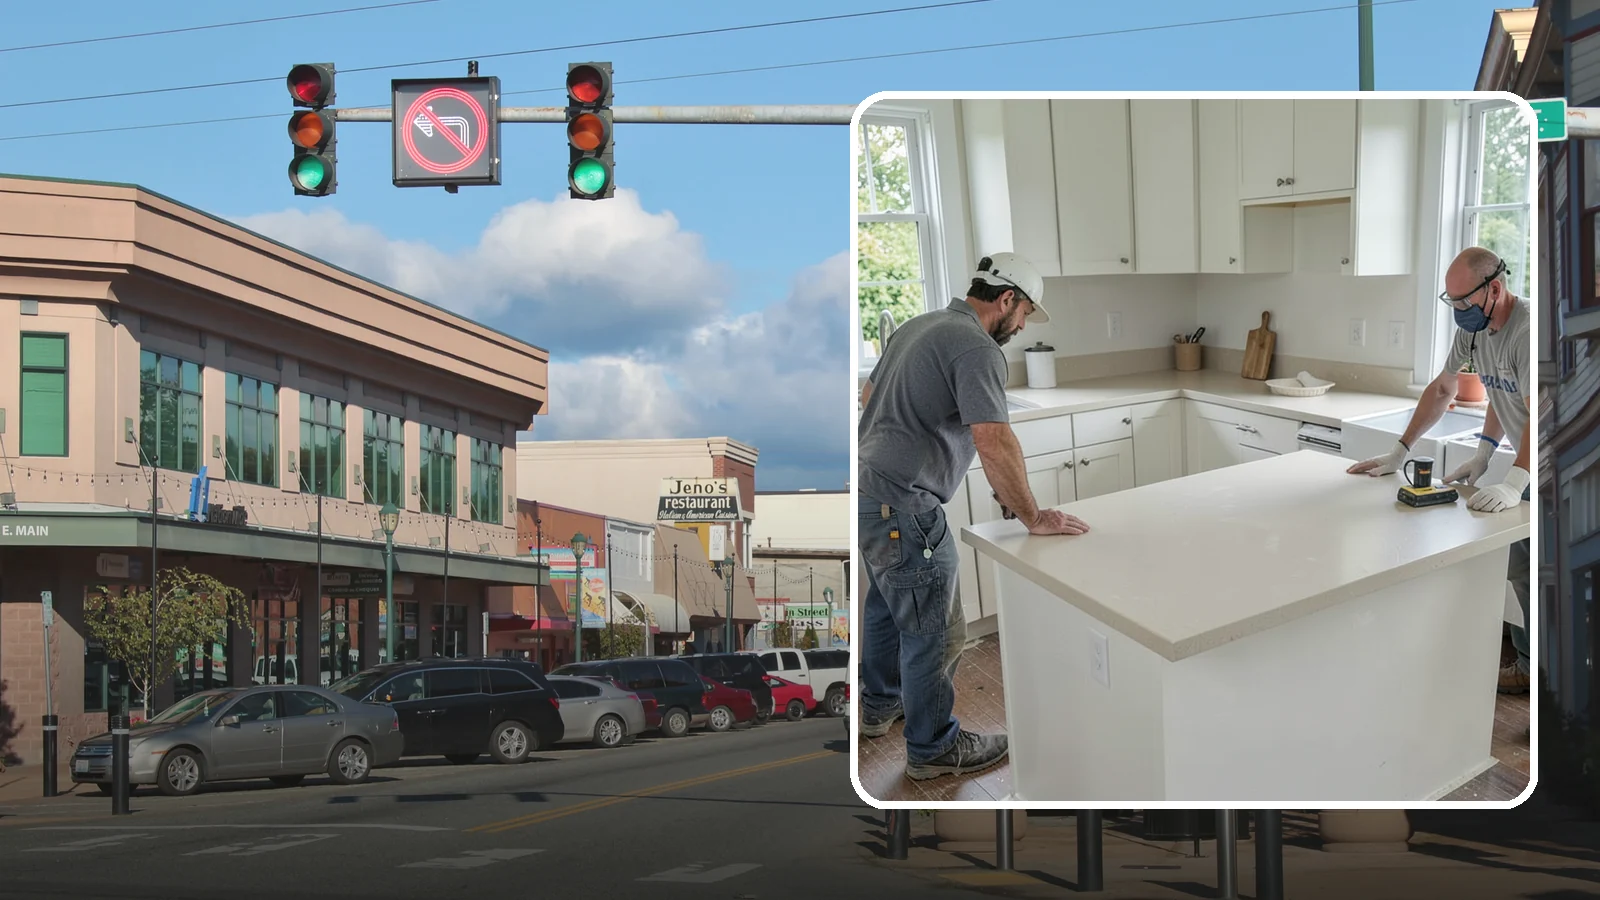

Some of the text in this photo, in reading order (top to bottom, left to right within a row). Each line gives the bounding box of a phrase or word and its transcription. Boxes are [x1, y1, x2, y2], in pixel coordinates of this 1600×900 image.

[670, 480, 727, 494] Jeno's
[665, 497, 731, 509] restaurant
[658, 510, 681, 519] Italian
[686, 509, 714, 519] American
[715, 510, 738, 519] Cuisine
[2, 525, 49, 536] E. MAIN
[797, 608, 828, 616] Street
